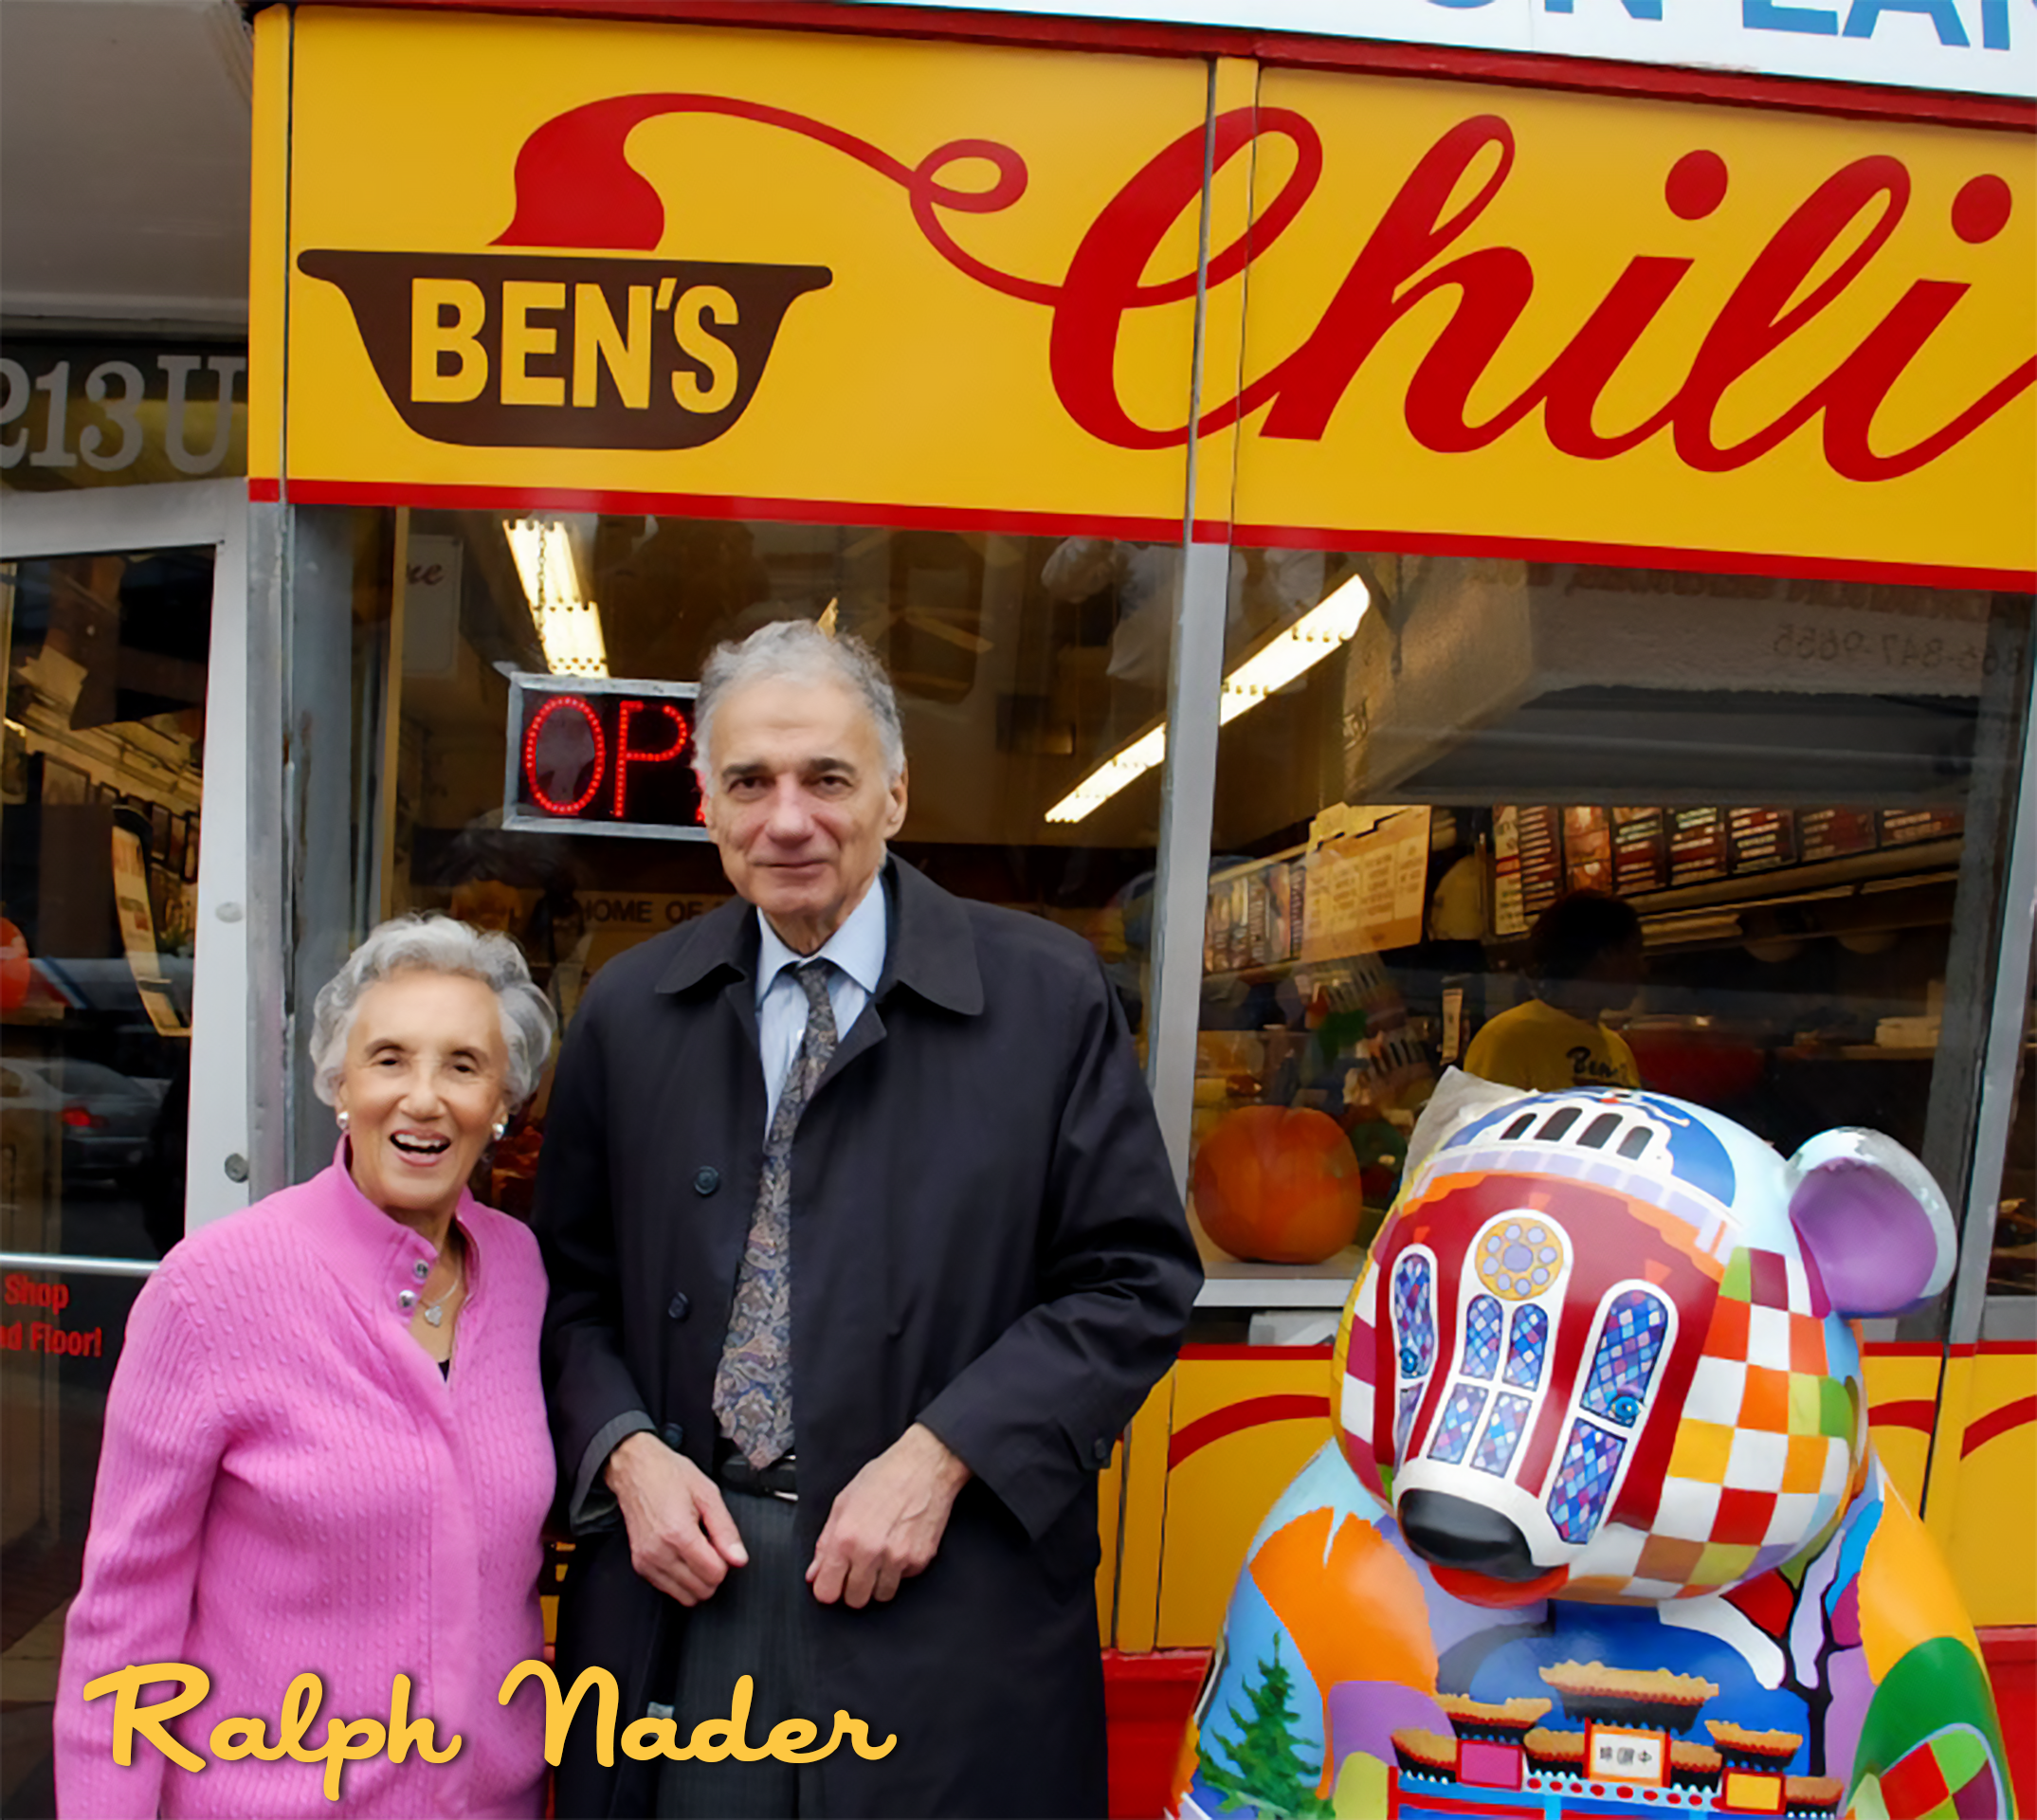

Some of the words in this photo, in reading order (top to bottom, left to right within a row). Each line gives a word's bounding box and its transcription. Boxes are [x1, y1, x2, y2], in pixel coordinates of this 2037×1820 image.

[410, 277, 739, 414] BEN'S
[1049, 106, 2037, 482] Chili
[524, 696, 706, 820] OP
[4, 1273, 69, 1316] Shop
